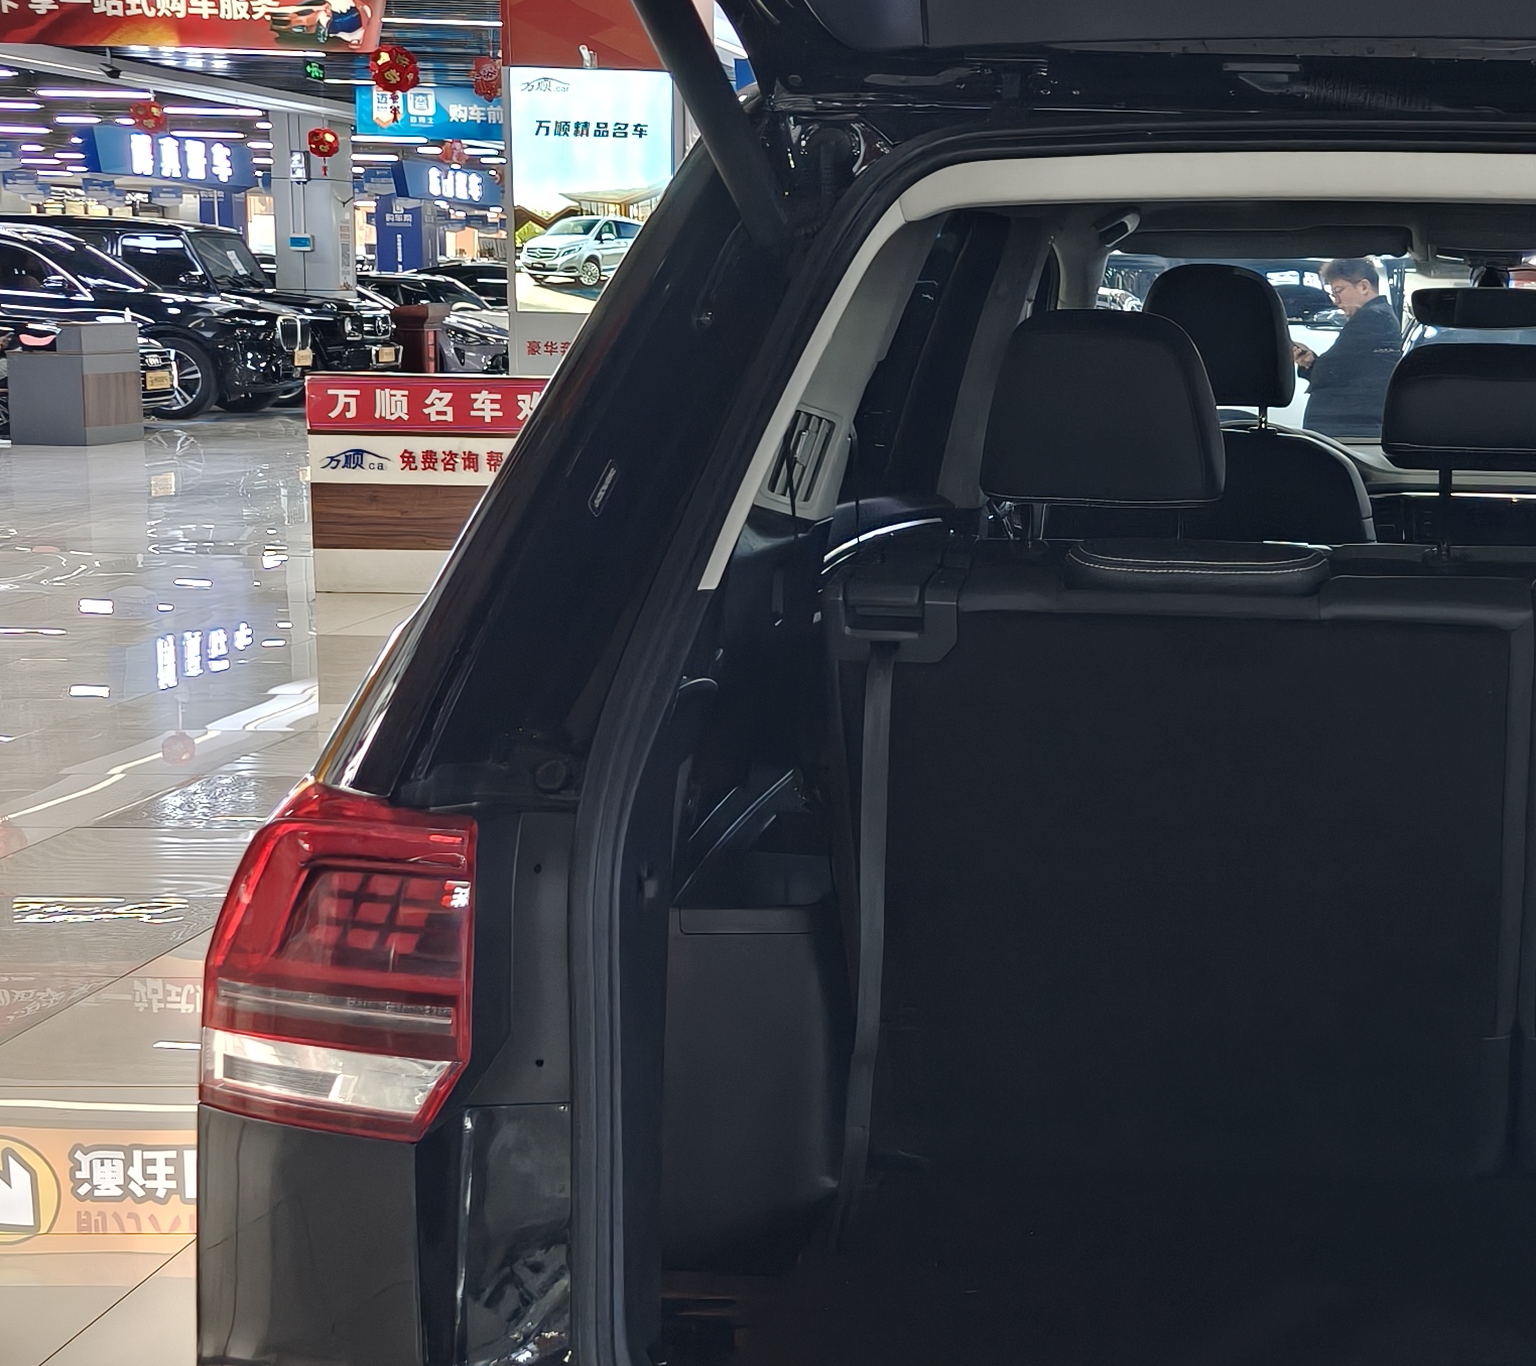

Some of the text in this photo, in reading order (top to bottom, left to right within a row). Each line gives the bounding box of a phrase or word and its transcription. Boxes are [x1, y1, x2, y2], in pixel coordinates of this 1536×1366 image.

[534, 119, 650, 139] 万顺精品名车
[400, 449, 480, 473] 免费咨询
